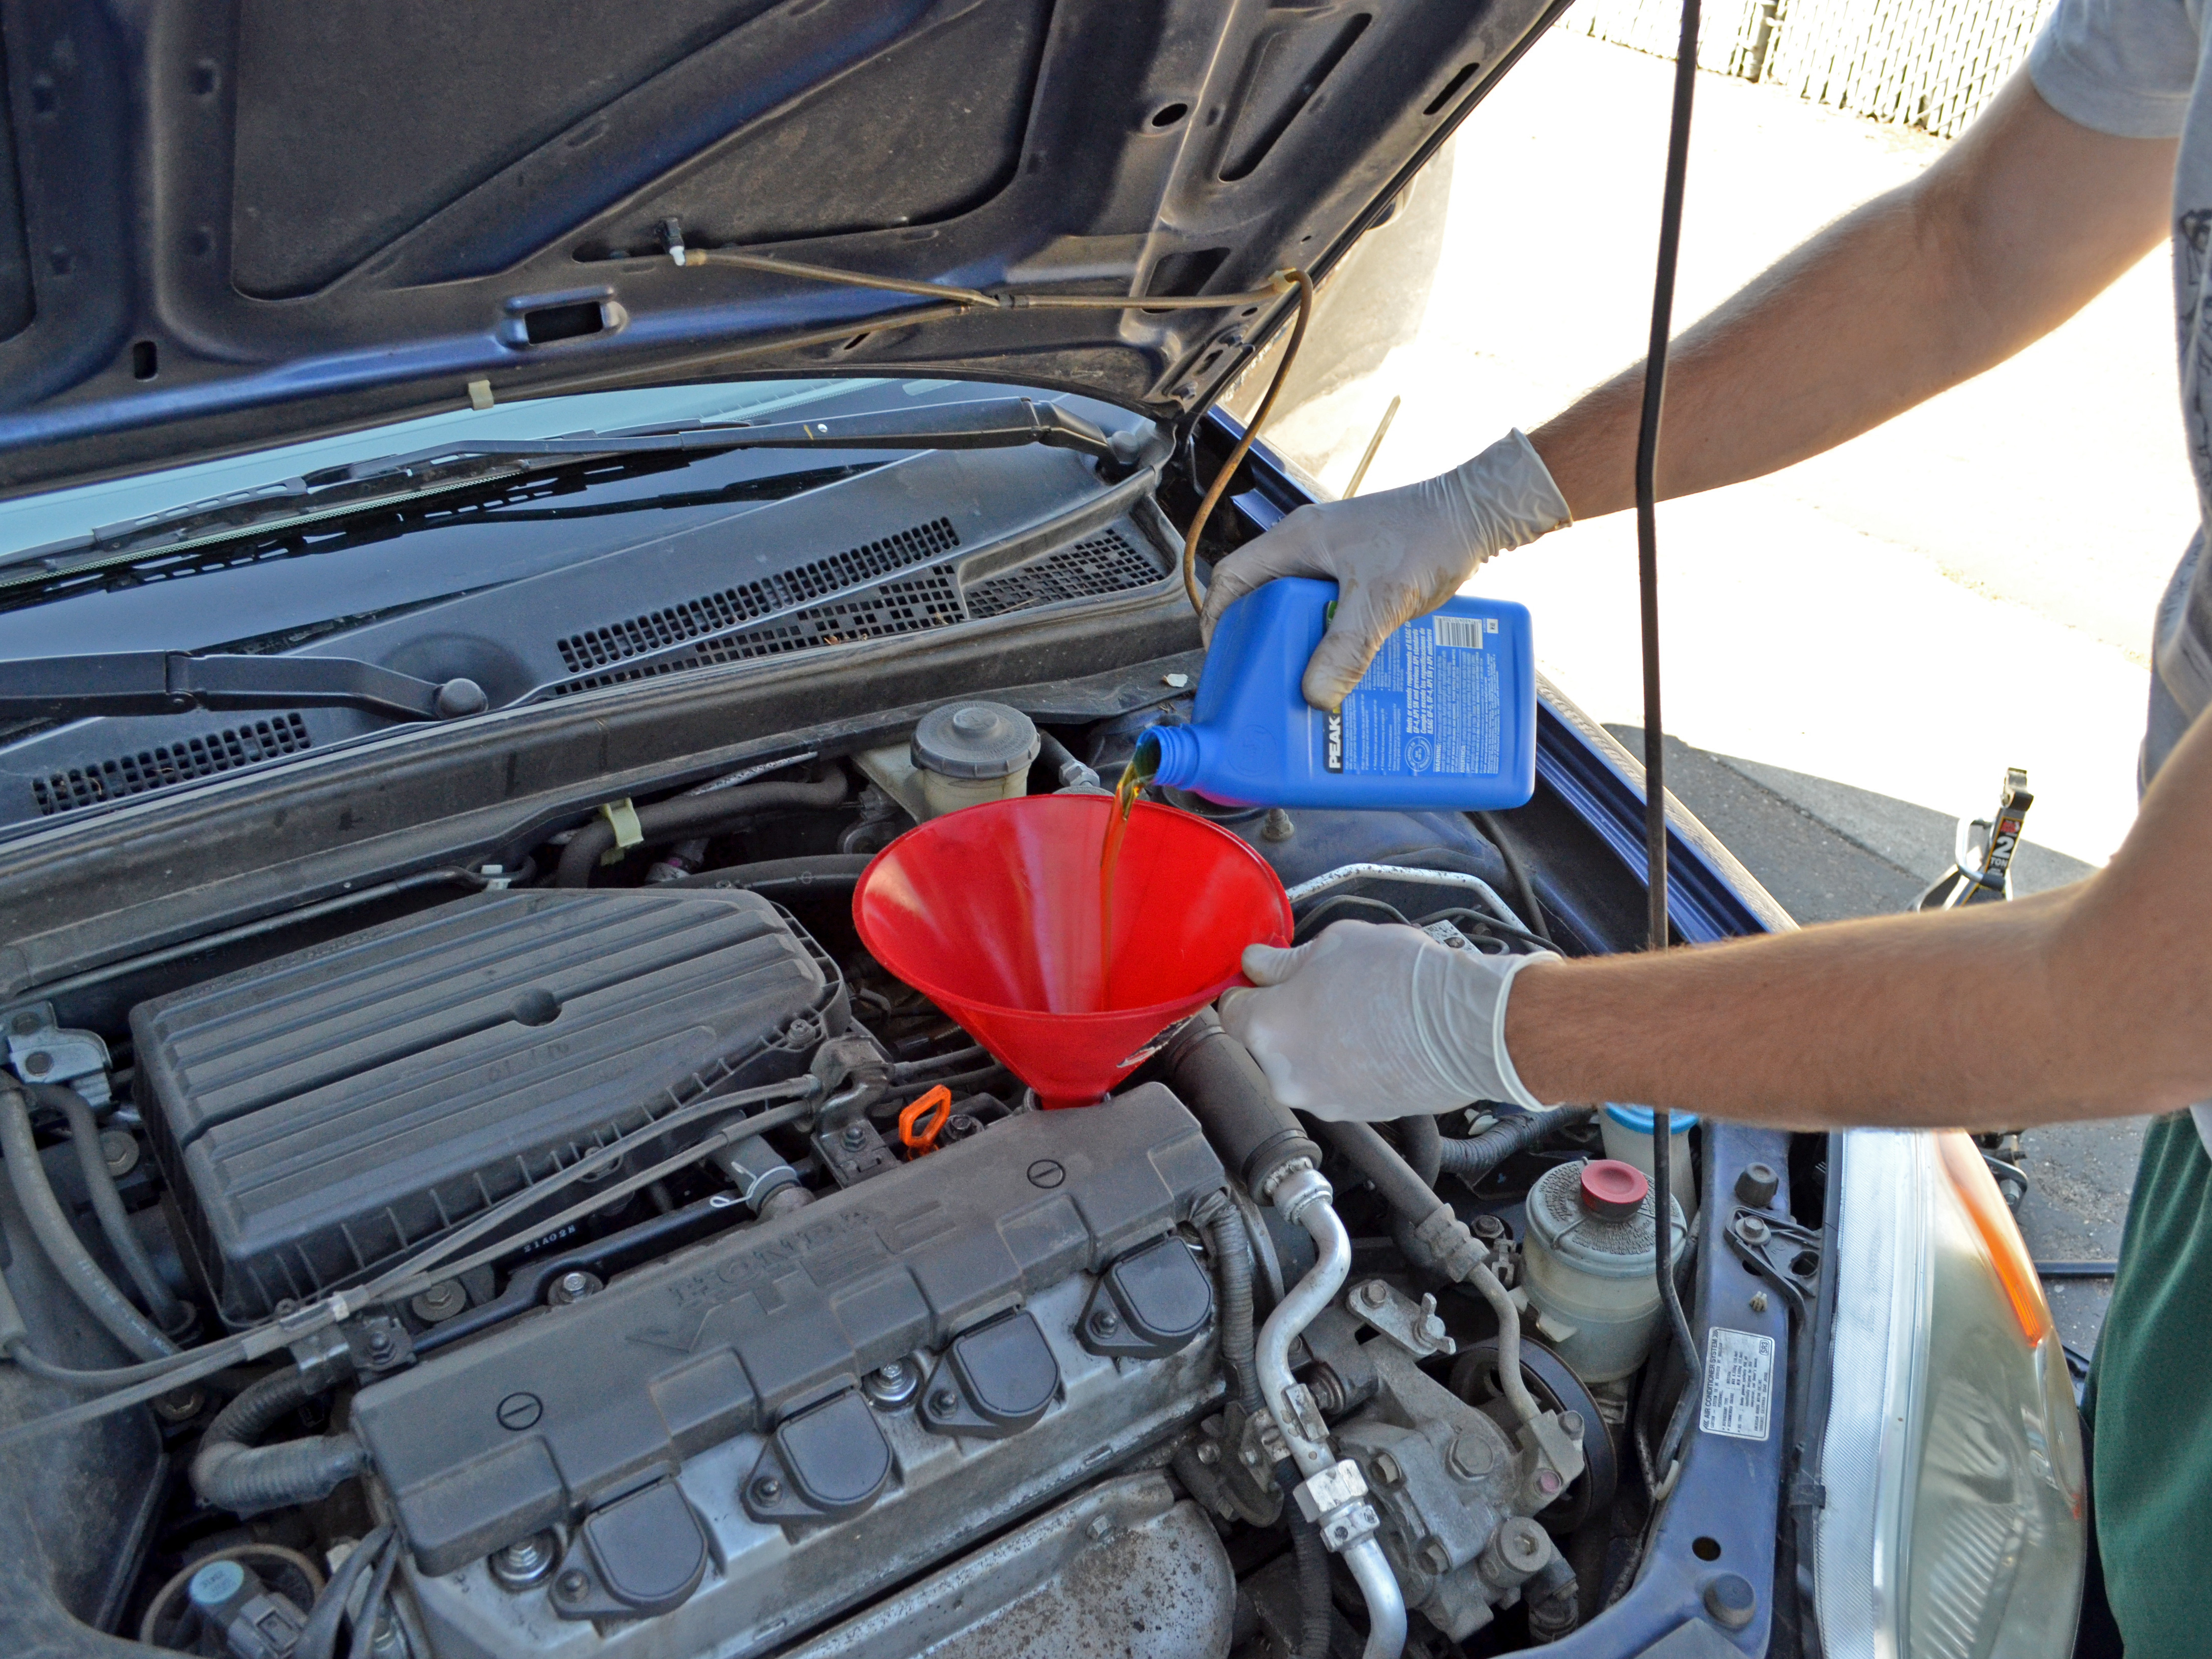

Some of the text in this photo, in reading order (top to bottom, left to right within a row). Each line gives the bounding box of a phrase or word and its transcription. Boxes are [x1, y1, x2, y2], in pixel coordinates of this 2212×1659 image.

[1329, 716, 1340, 768] PEAK
[1991, 836, 2014, 857] 2
[1990, 857, 2008, 867] TON
[1709, 1339, 1718, 1363] SYSTEM
[1705, 1365, 1715, 1406] CONDITIONER
